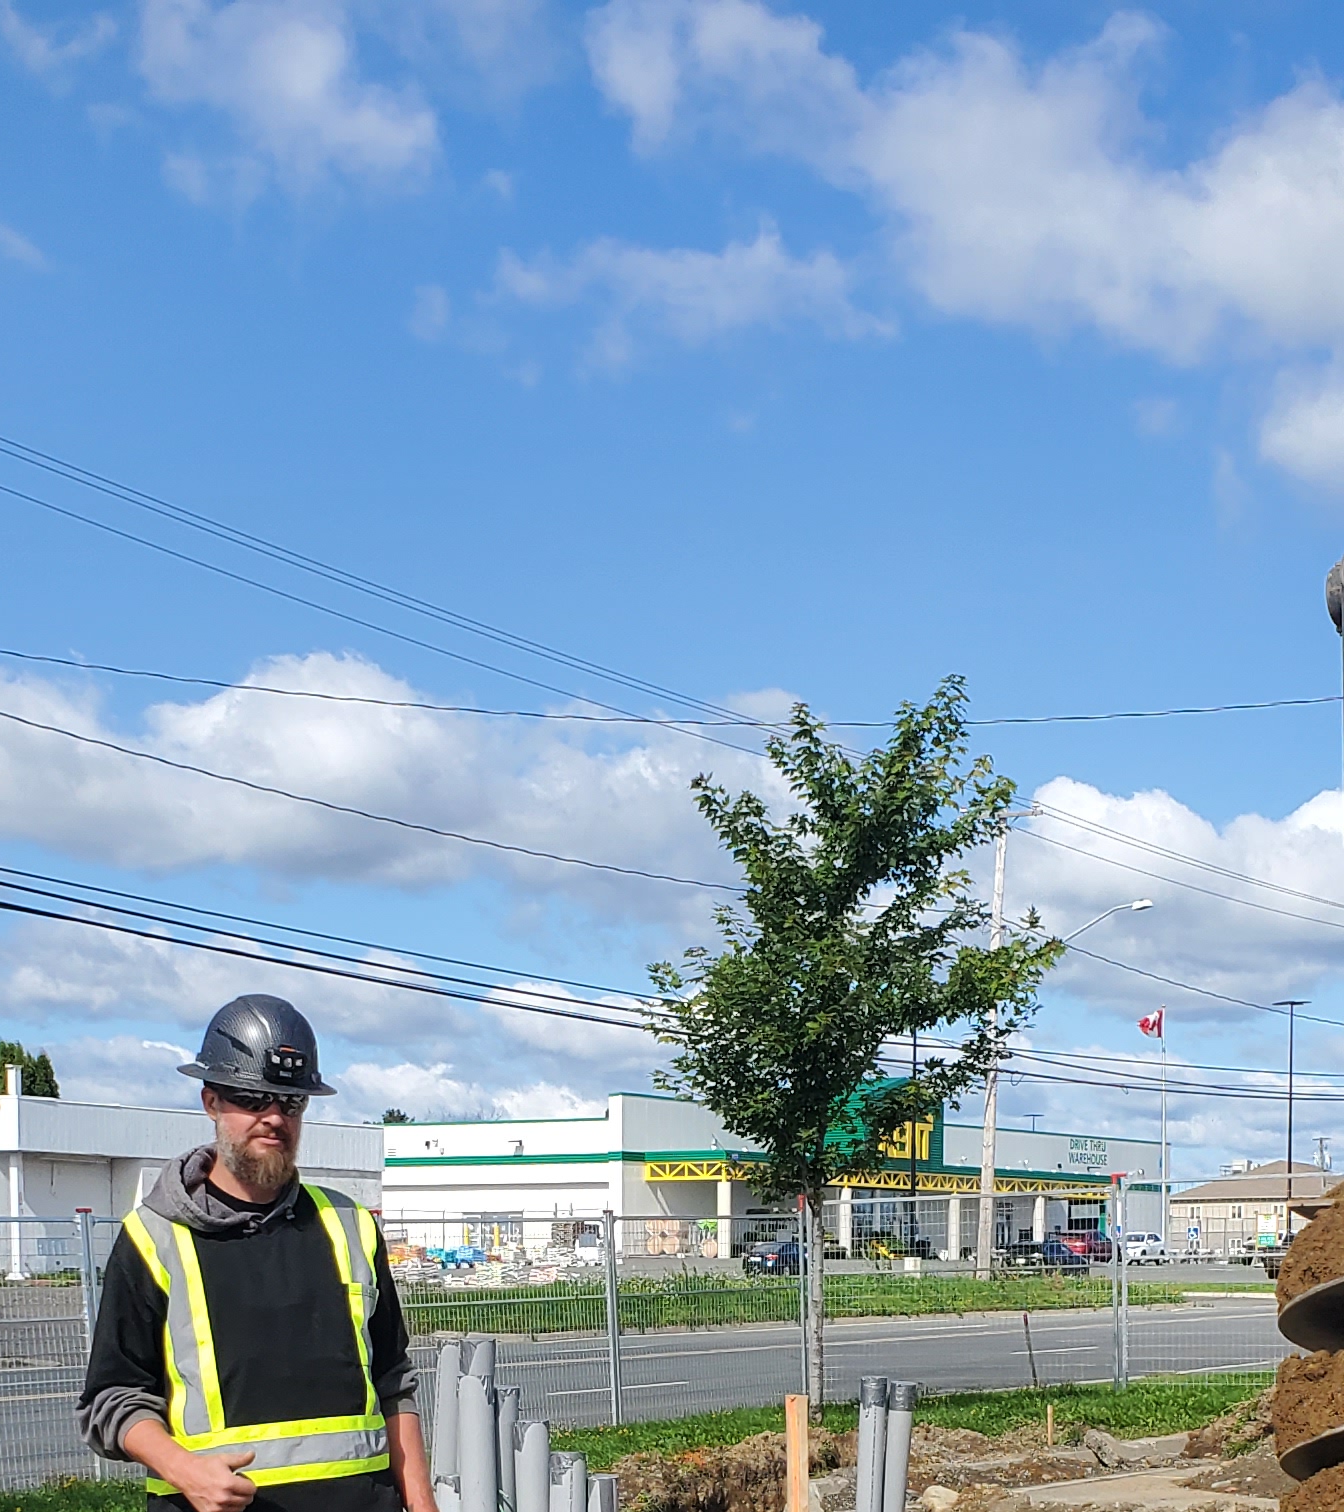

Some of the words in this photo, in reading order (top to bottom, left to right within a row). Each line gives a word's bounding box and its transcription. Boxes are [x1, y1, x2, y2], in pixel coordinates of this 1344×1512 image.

[1069, 1138, 1088, 1151] DRIVE
[1089, 1139, 1107, 1152] THRU
[1068, 1151, 1108, 1166] WAREHOUSE
